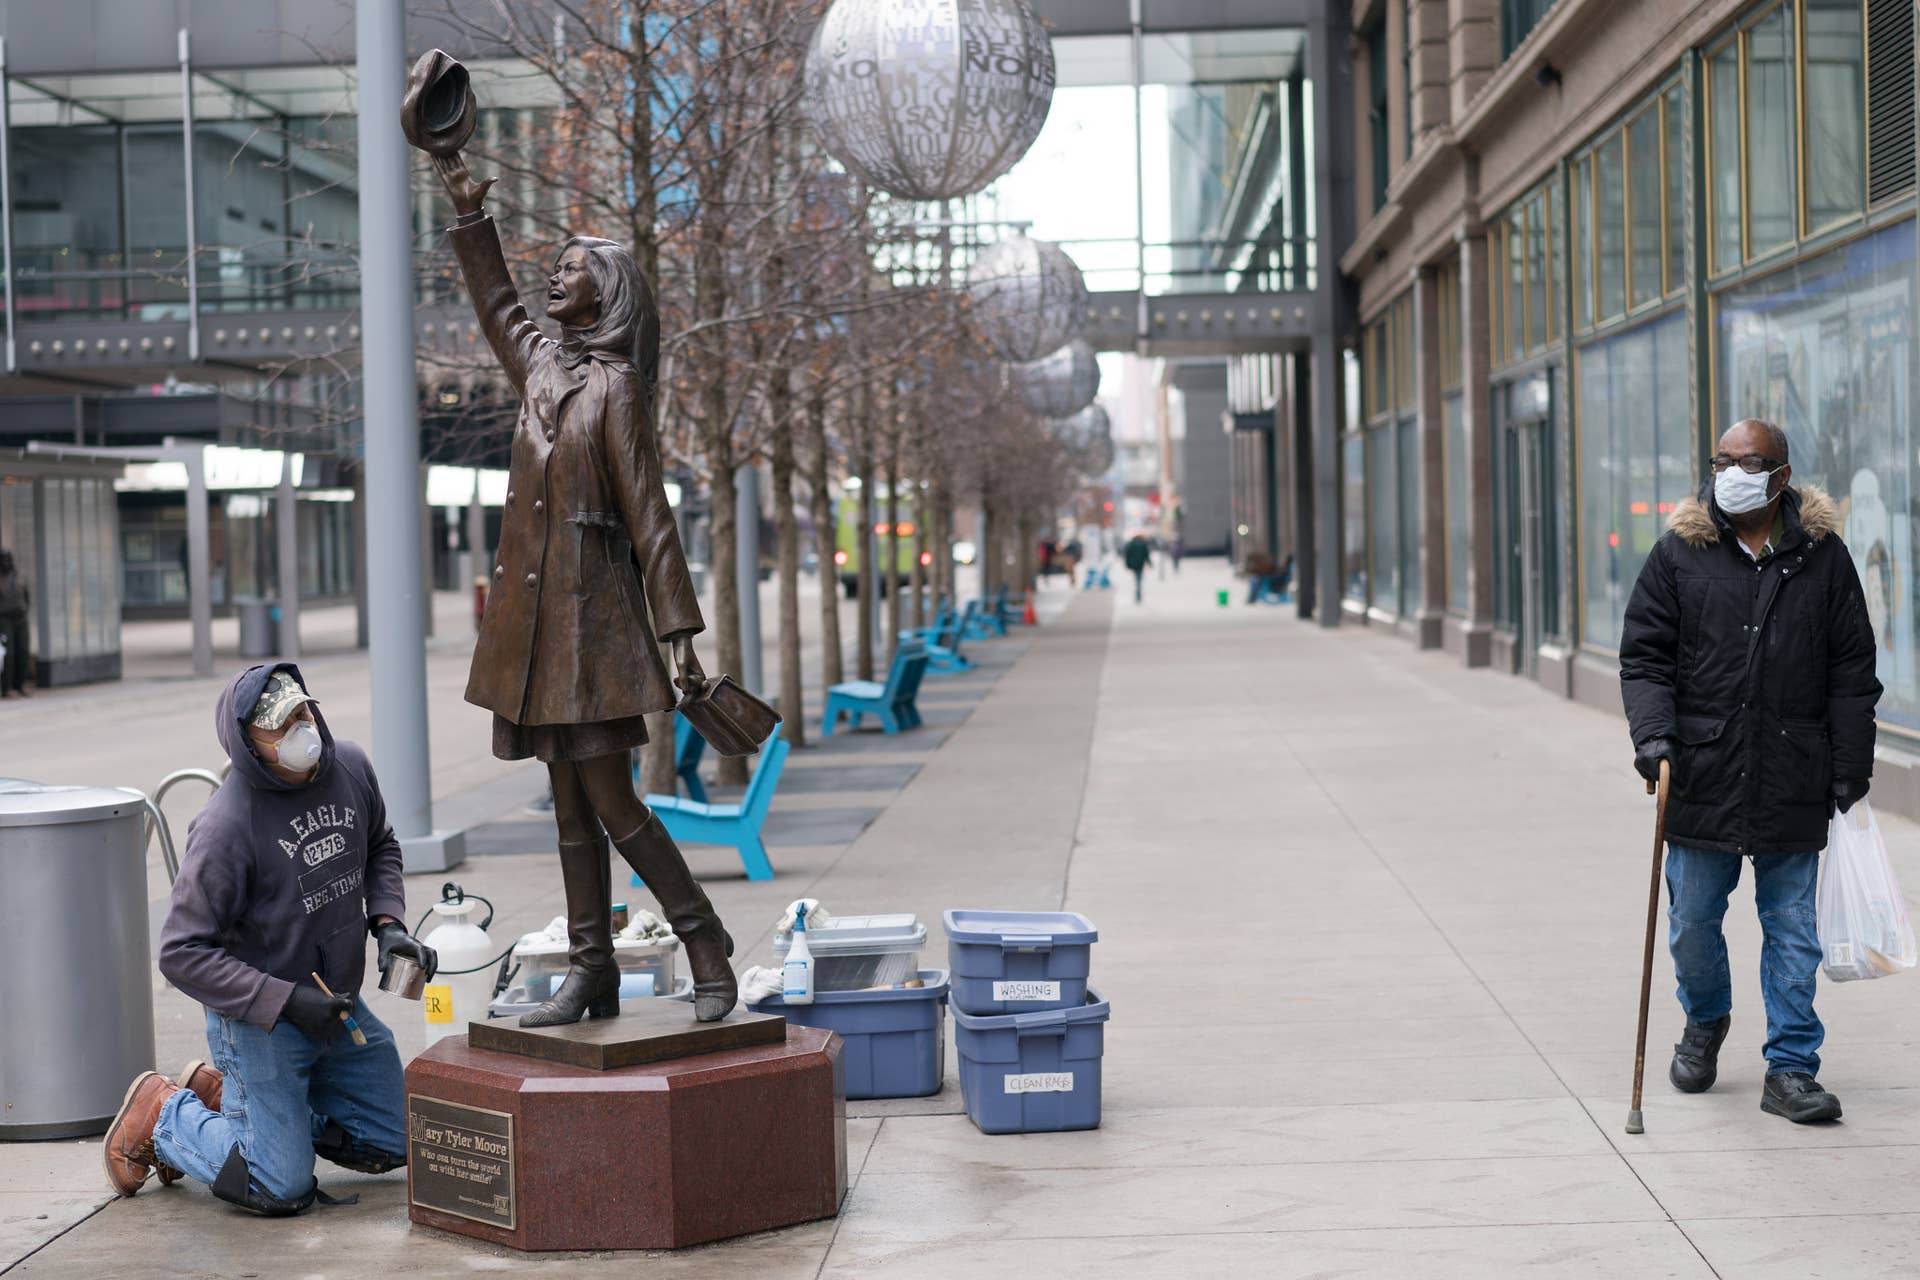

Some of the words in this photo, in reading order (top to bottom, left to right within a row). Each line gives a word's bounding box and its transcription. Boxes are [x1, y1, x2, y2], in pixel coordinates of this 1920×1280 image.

[1000, 983, 1052, 996] WASHING
[1010, 1078, 1042, 1090] CLEAN
[410, 1112, 443, 1144] Mary
[445, 1130, 472, 1148] Tyler
[474, 1136, 507, 1156] Moore
[420, 1147, 436, 1160] Who
[436, 1153, 449, 1164] can
[450, 1155, 468, 1167] turn
[467, 1159, 480, 1171] the
[480, 1163, 502, 1176] world
[439, 1164, 456, 1176] with
